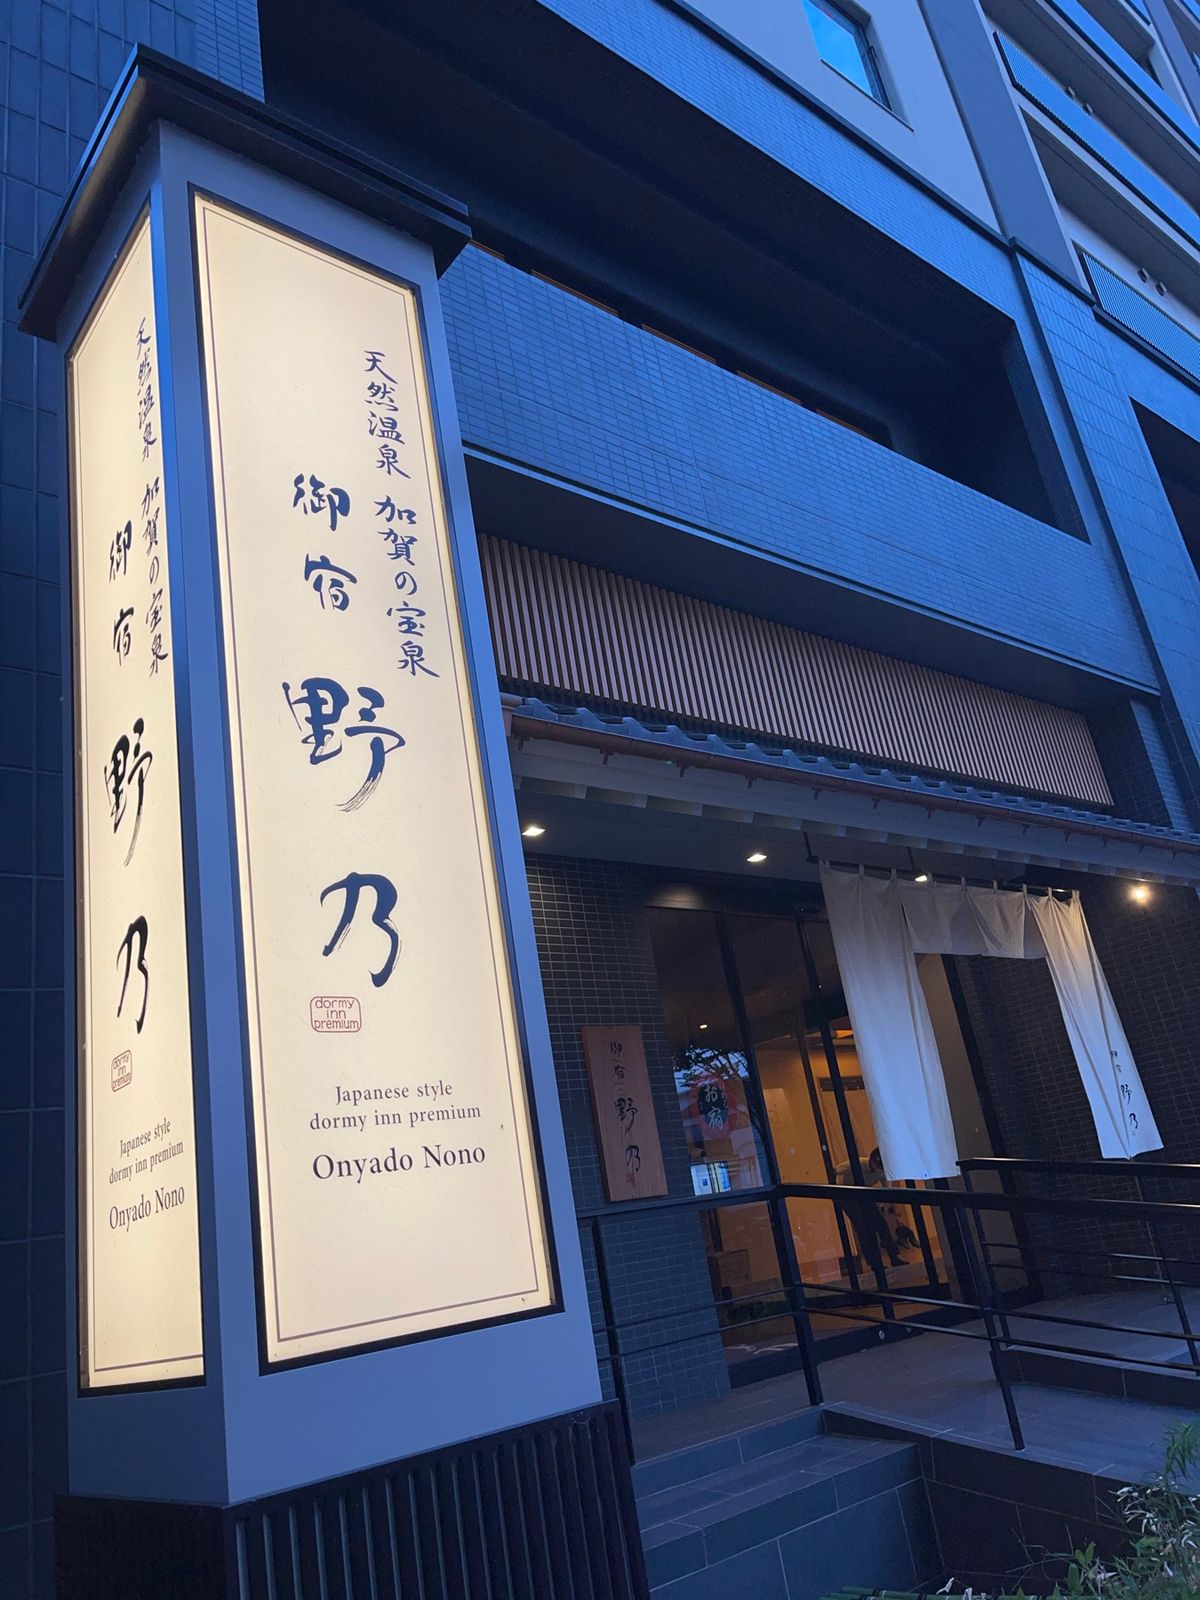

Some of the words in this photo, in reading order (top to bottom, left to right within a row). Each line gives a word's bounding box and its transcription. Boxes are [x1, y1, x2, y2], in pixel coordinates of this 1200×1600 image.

[136, 316, 158, 463] 天然温泉
[363, 350, 411, 479] 天然温泉
[141, 476, 168, 678] 加賀の宝泉
[374, 495, 440, 678] 加賀の宝泉
[282, 473, 405, 989] 御宿野乃
[313, 1019, 359, 1029] premium
[315, 997, 354, 1009] dormy
[326, 1009, 347, 1019] inn
[335, 1086, 410, 1106] Japanese
[416, 1080, 453, 1101] style
[119, 1130, 151, 1158] Japanese
[153, 1117, 171, 1141] style
[309, 1113, 368, 1132] dormy
[374, 1110, 402, 1126] inn
[409, 1105, 481, 1128] premium
[109, 1164, 133, 1184] dormy
[135, 1157, 148, 1174] inn
[150, 1141, 184, 1172] premium
[312, 1147, 414, 1184] Onyado
[421, 1144, 486, 1169] Nono
[109, 1193, 151, 1232] Onyado
[155, 1186, 185, 1214] Nono
